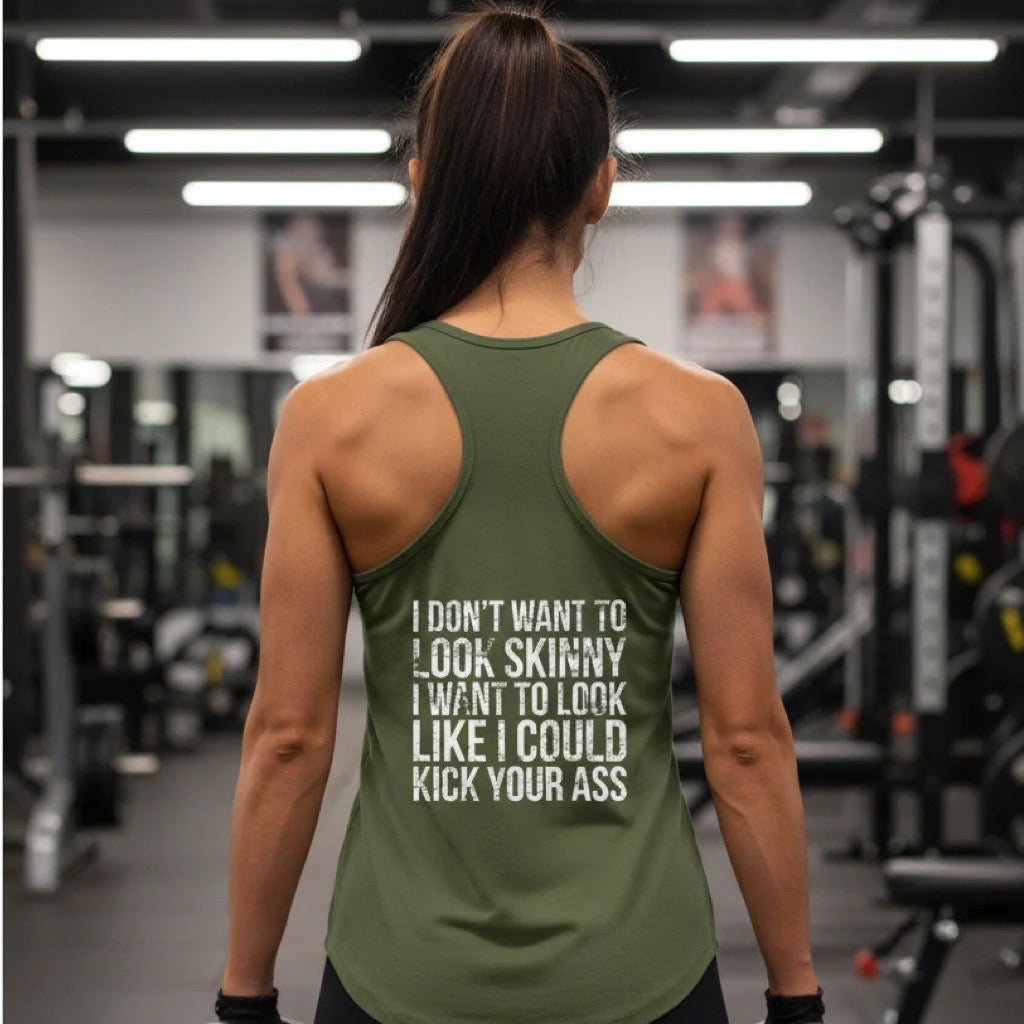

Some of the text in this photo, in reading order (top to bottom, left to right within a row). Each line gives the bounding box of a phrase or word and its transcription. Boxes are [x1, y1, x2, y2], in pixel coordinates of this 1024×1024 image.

[413, 599, 627, 632] I DON'T WANT TO
[413, 637, 626, 678] LOOK SKINNY
[413, 682, 627, 716] I WANT TO LOOK
[413, 719, 627, 762] LIKE I COULD
[413, 766, 627, 801] KICK YOUR ASS
